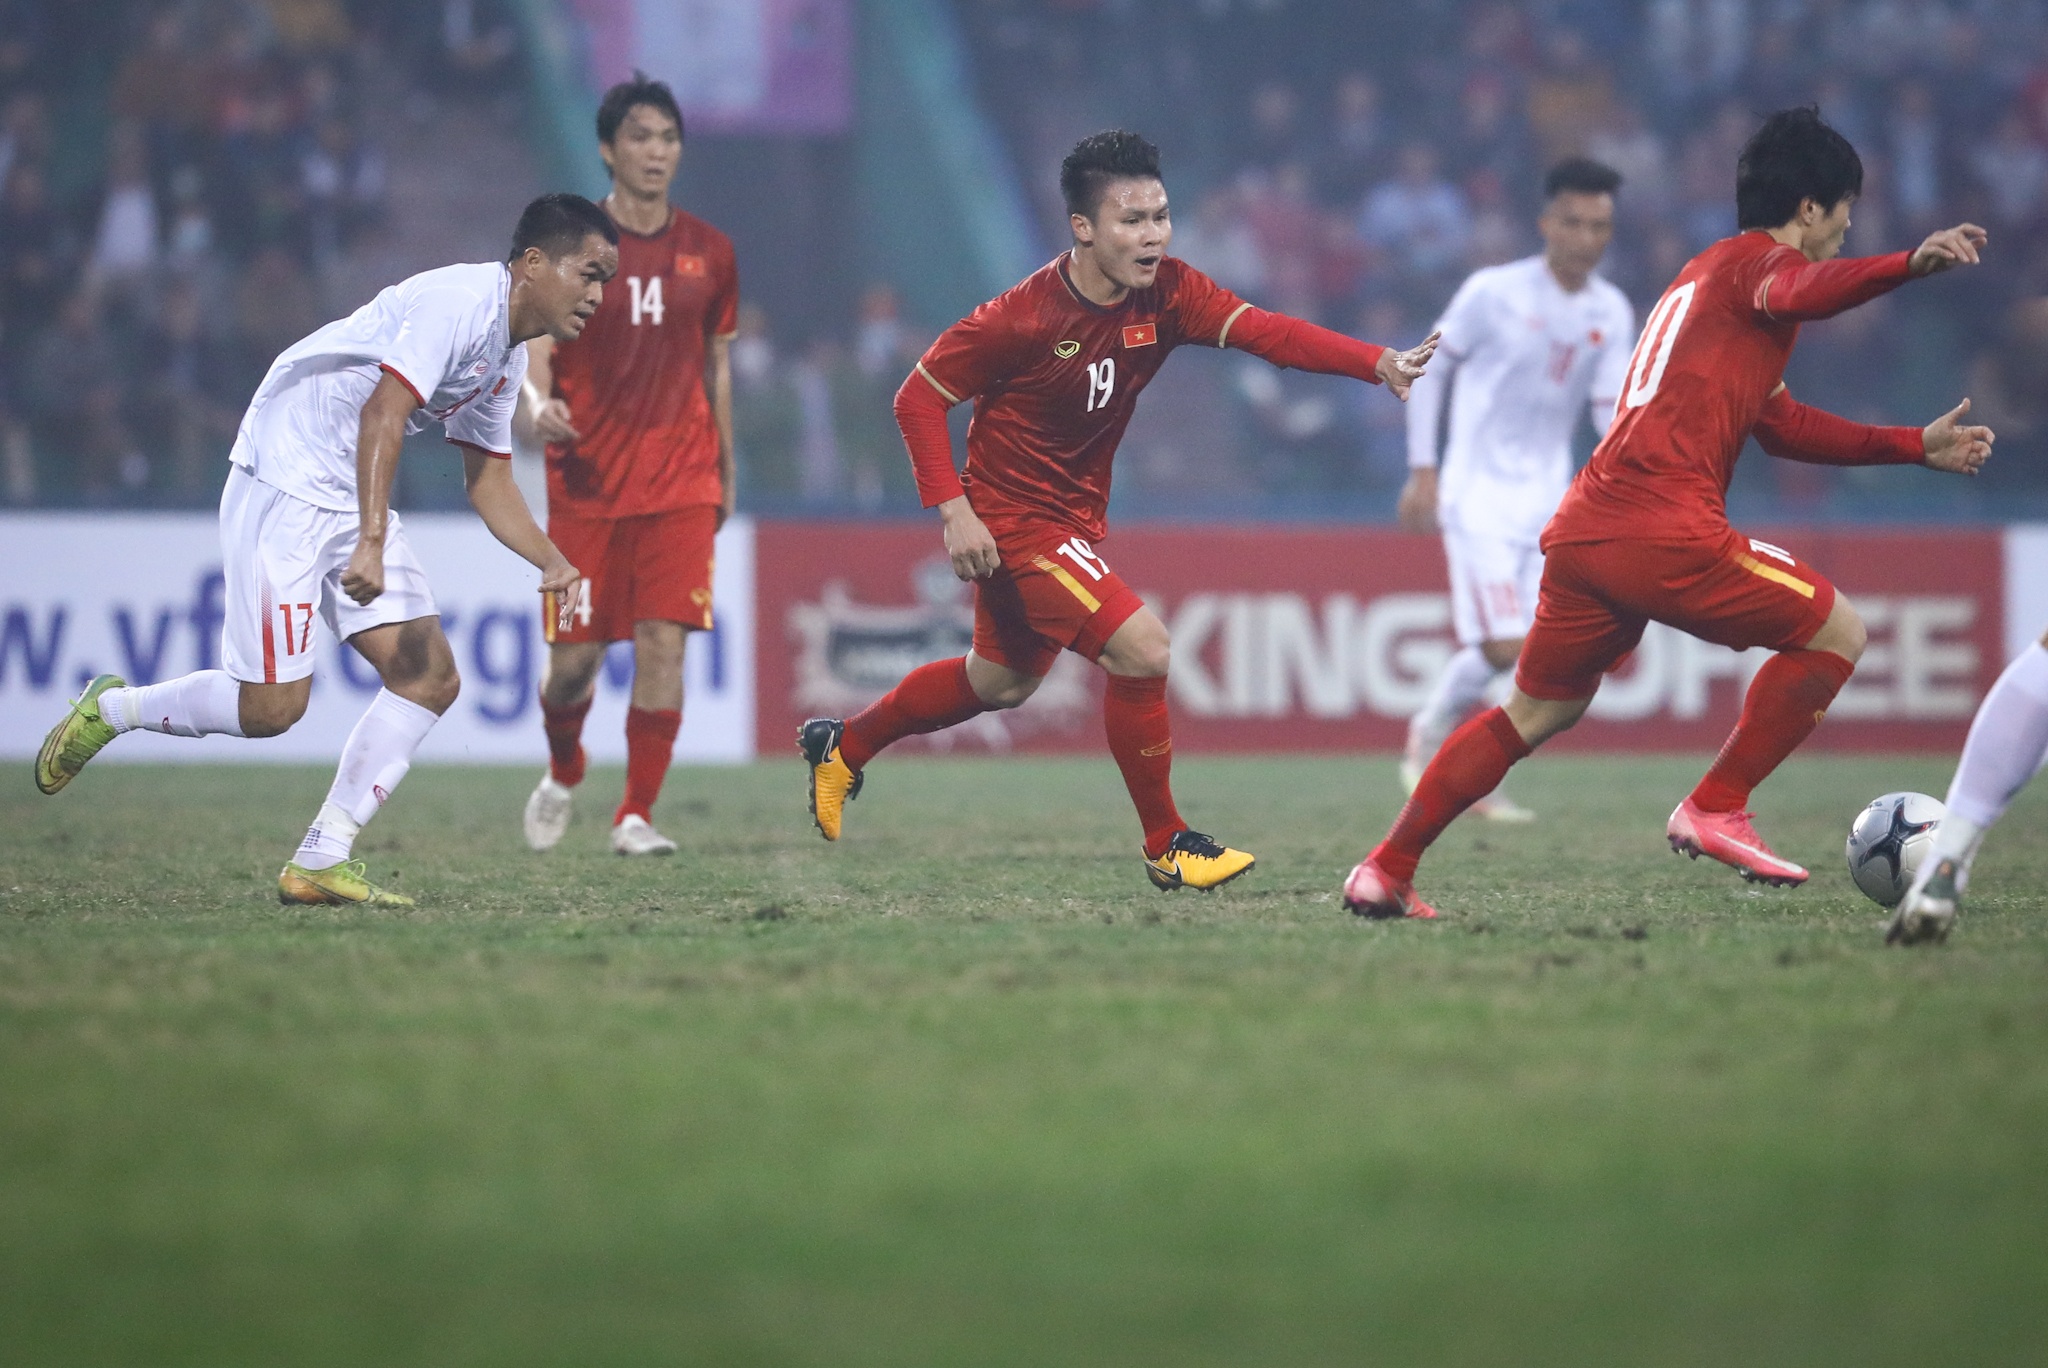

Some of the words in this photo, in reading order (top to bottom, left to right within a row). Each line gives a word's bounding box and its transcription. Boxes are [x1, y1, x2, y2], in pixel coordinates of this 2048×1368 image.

[626, 275, 665, 326] 14
[1613, 280, 1696, 412] 0
[1086, 357, 1115, 413] 19
[1056, 536, 1110, 581] 19
[574, 577, 593, 626] 4
[279, 603, 313, 656] 17
